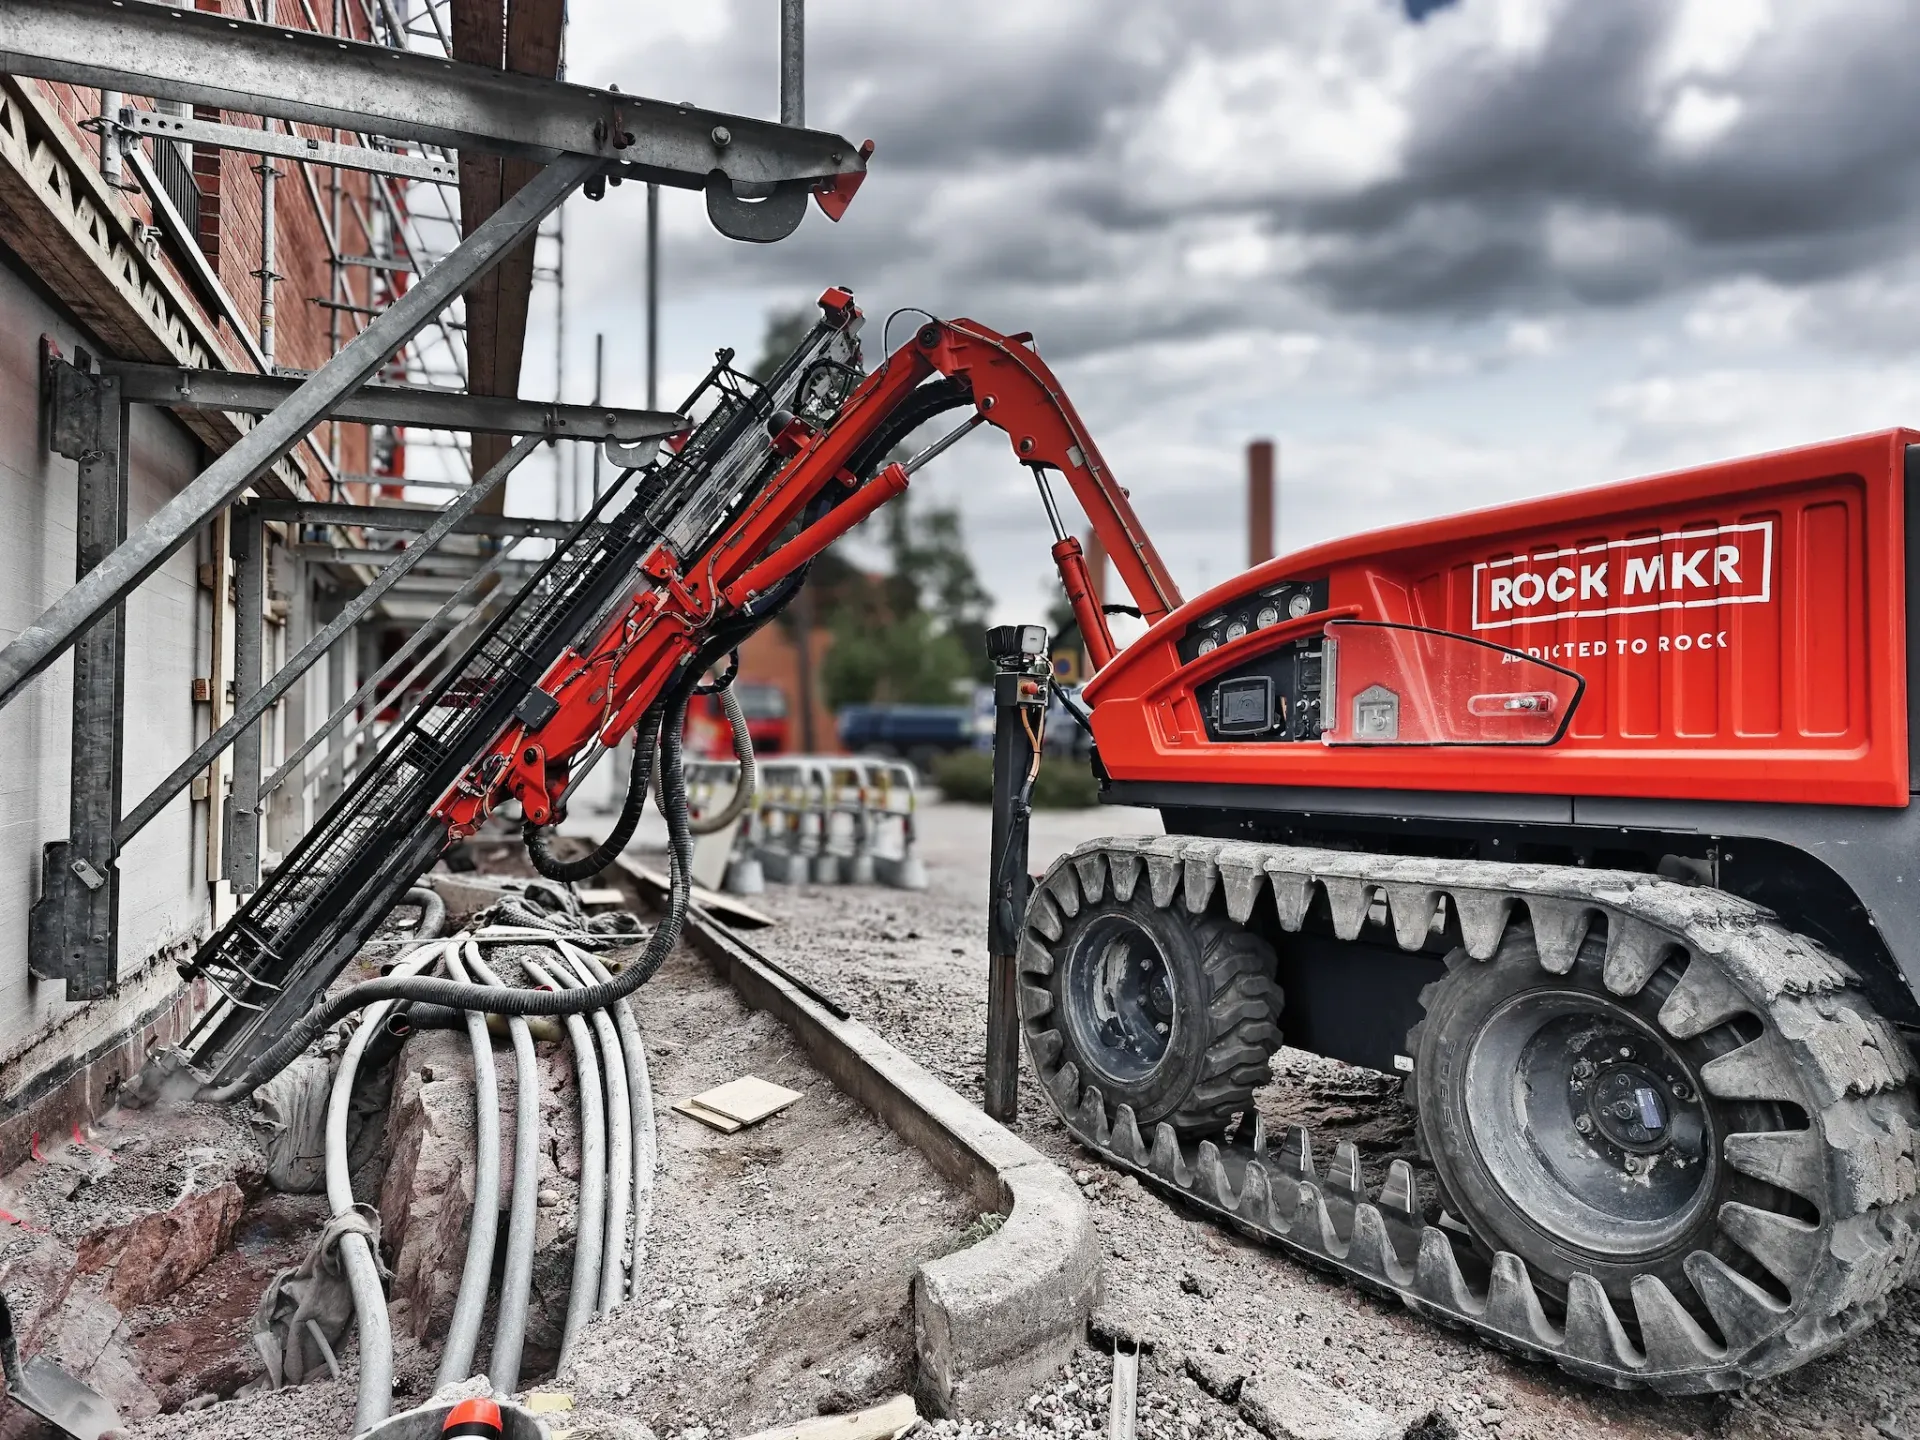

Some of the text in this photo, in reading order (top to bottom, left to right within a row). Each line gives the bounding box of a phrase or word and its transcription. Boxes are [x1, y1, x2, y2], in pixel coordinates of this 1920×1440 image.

[1490, 545, 1743, 612] ROCK MKR
[1615, 637, 1648, 656] TO
[1658, 630, 1728, 652] ROCK
